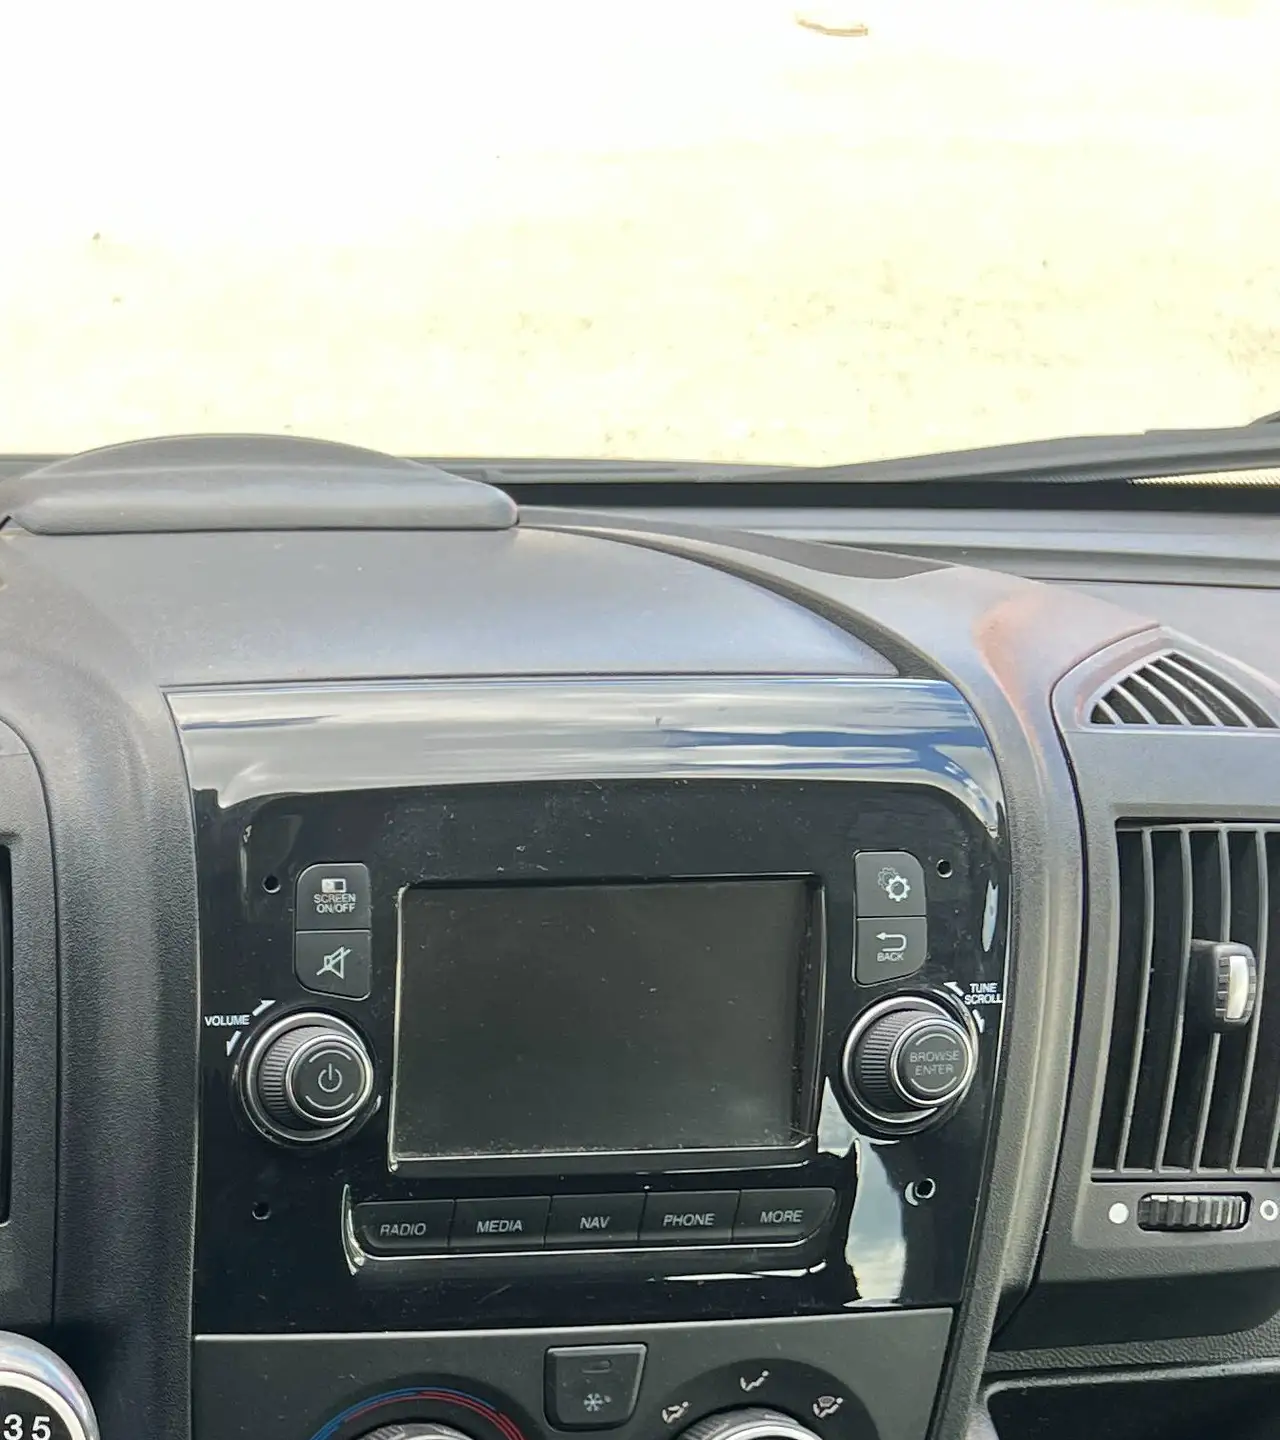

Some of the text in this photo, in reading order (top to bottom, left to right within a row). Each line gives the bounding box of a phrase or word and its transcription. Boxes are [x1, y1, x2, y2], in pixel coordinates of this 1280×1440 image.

[313, 893, 356, 904] SCREEN
[876, 952, 904, 962] BACK
[969, 982, 998, 994] TUNE
[964, 993, 1003, 1005] SCROLL
[204, 1014, 250, 1027] VOLUME
[909, 1050, 960, 1063] BROWSE
[914, 1064, 954, 1077] ENTER
[579, 1215, 610, 1229] NAV
[662, 1212, 715, 1227] PHONE
[759, 1209, 802, 1223] MORE
[379, 1222, 426, 1236] RADIO
[475, 1218, 523, 1233] MEDIA
[3, 1414, 23, 1440] 3
